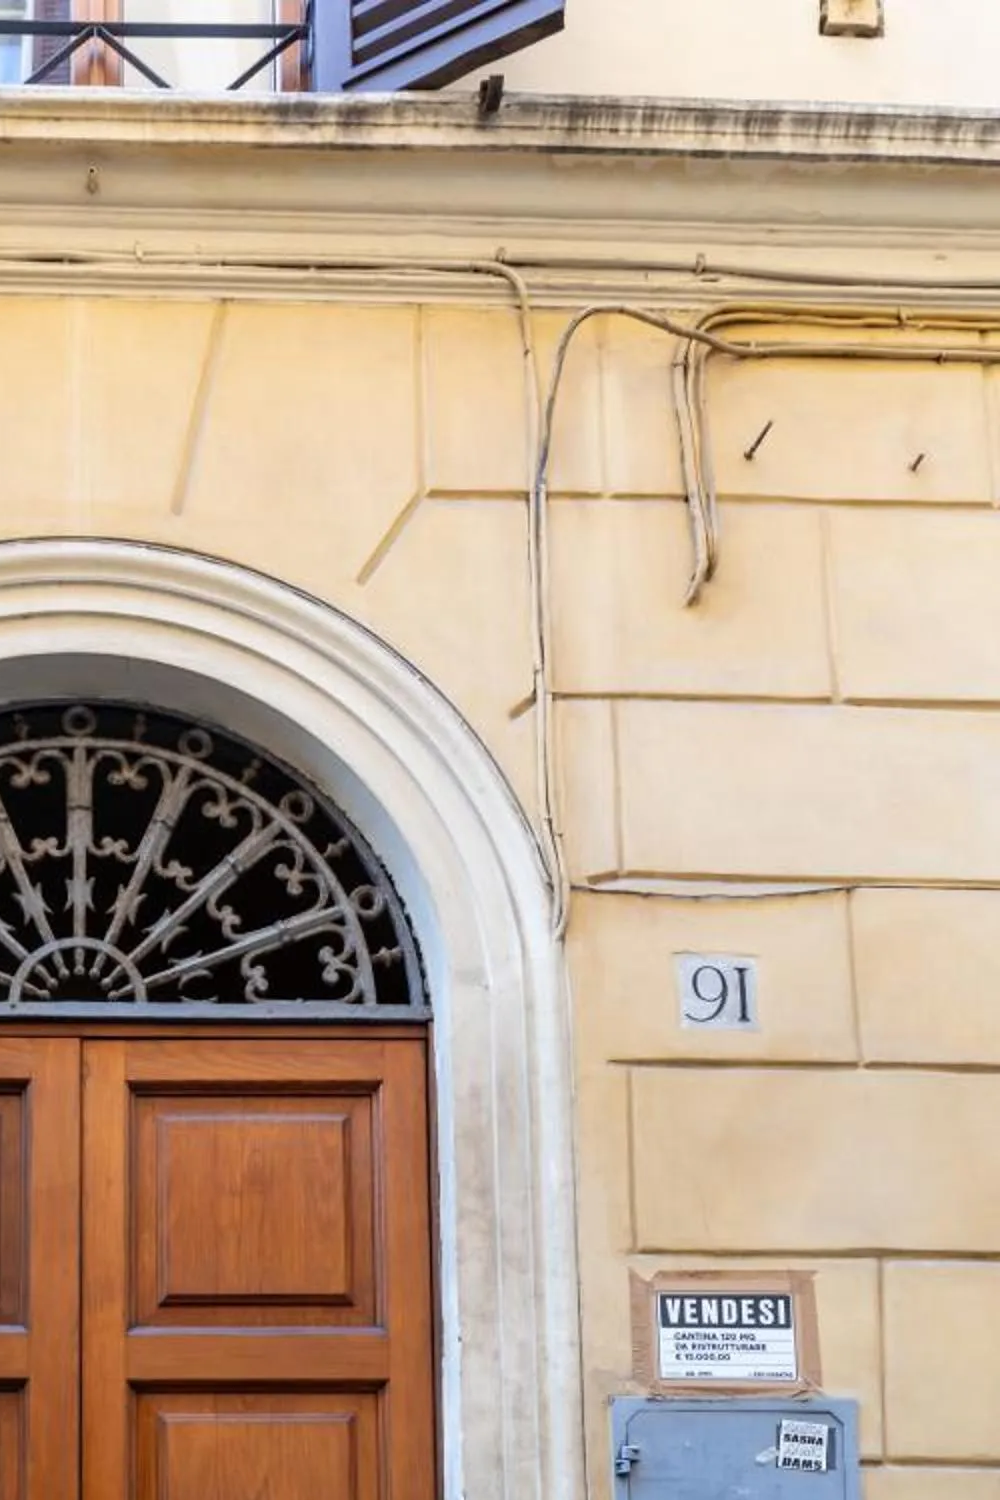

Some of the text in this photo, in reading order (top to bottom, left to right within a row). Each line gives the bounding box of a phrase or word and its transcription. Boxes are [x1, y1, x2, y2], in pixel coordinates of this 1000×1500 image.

[684, 965, 751, 1022] 91
[665, 1298, 787, 1325] VENDESI
[673, 1332, 719, 1341] CANTINA
[739, 1333, 757, 1342] MQ
[675, 1343, 767, 1351] DA RISTRUTTURARE
